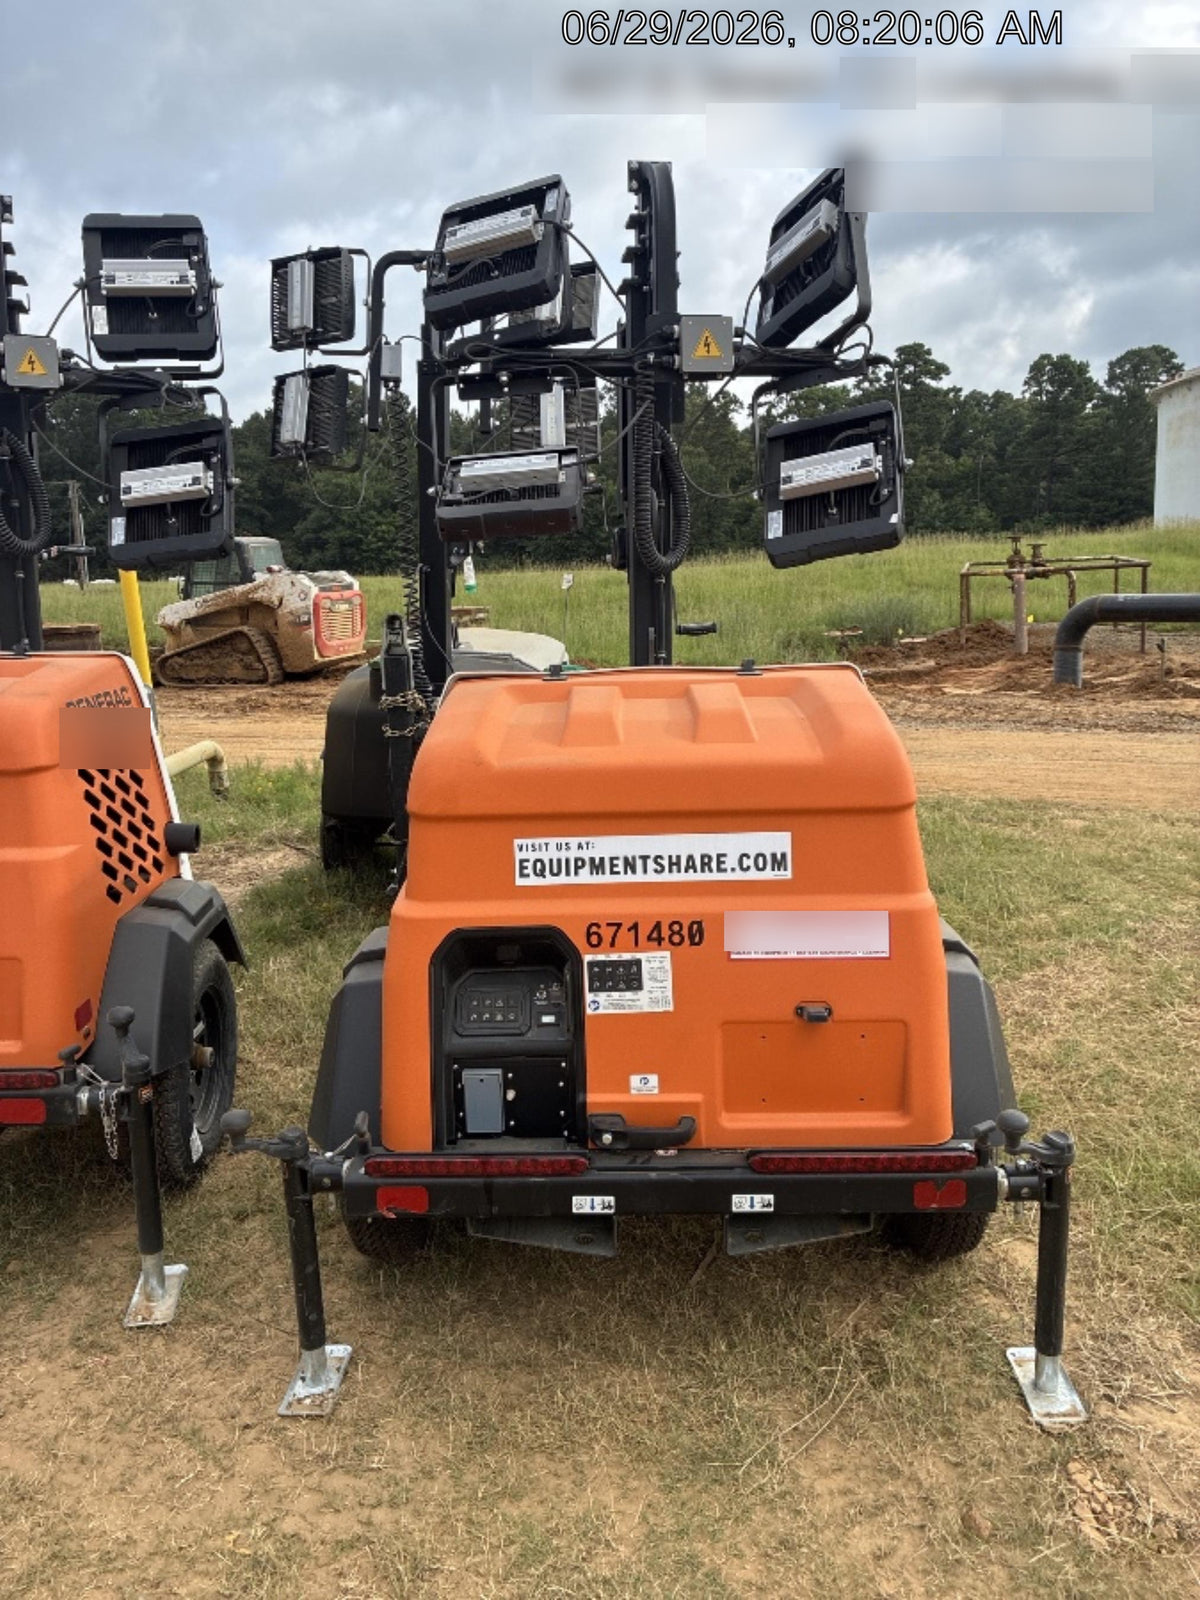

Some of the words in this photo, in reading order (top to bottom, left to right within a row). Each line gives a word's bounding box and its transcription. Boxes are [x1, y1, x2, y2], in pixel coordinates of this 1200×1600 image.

[517, 842, 550, 853] VISIT
[556, 841, 572, 852] US
[577, 840, 596, 851] AT:
[518, 851, 788, 879] EQUIPMENTSHARE.COM
[585, 919, 705, 949] 671480
